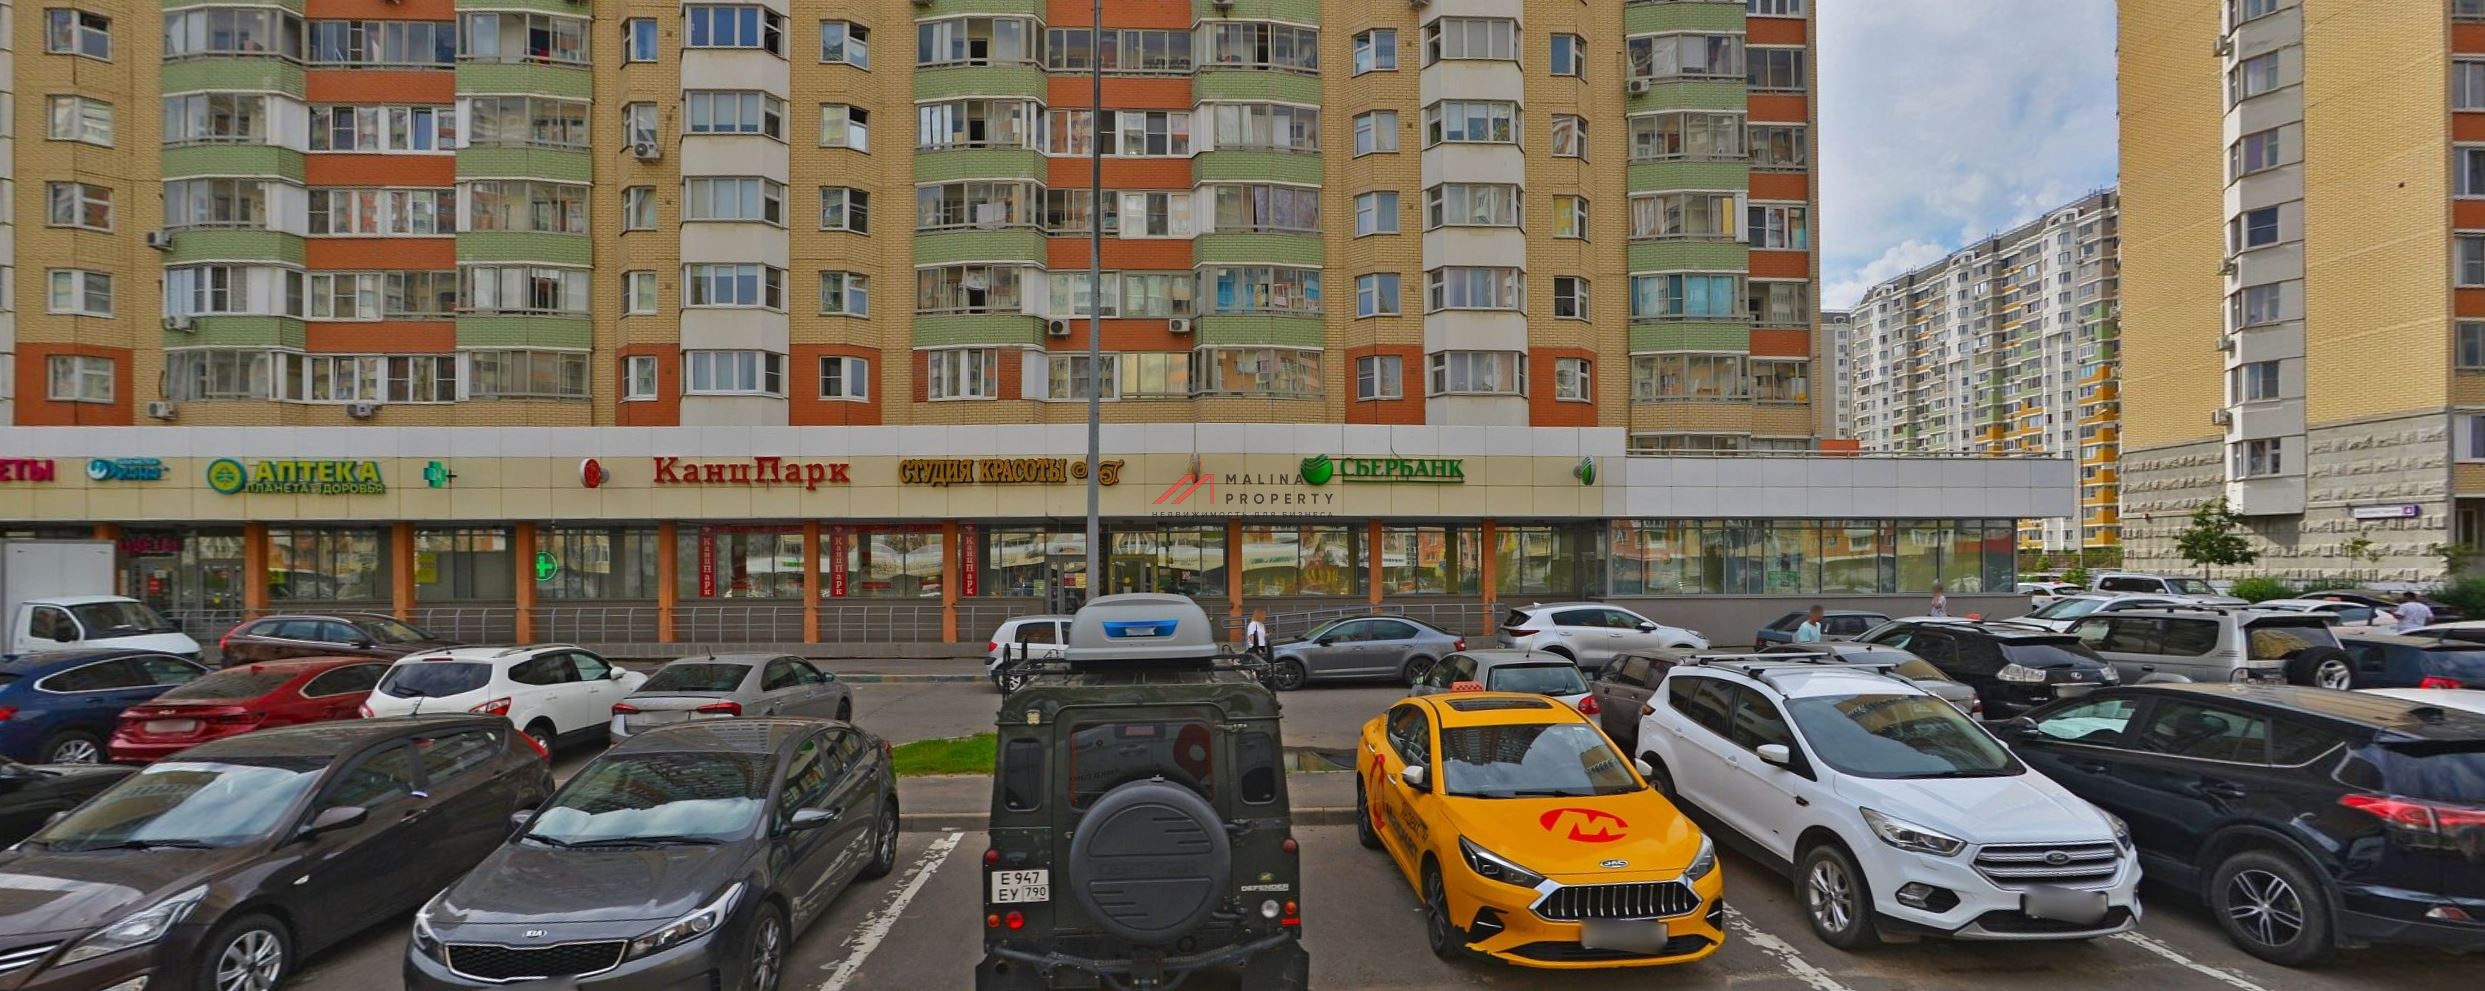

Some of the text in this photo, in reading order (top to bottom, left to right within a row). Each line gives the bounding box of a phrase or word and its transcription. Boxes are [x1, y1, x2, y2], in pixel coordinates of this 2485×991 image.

[254, 460, 382, 483] АПТЕКА
[653, 456, 850, 490] КанцПарк
[899, 458, 1067, 487] СТУДИЯ КРАСОТЫ
[1340, 457, 1464, 479] СБЕРБАНК
[244, 483, 386, 495] ПЛАНЕТА ЗДОРОВЬЯ
[703, 537, 713, 596] КанцПарк
[834, 537, 844, 596] КанцПарк
[965, 537, 975, 596] КанцПарк
[1001, 871, 1040, 885] Е 947
[1241, 883, 1290, 892] DEFENDER
[1025, 886, 1046, 897] 790
